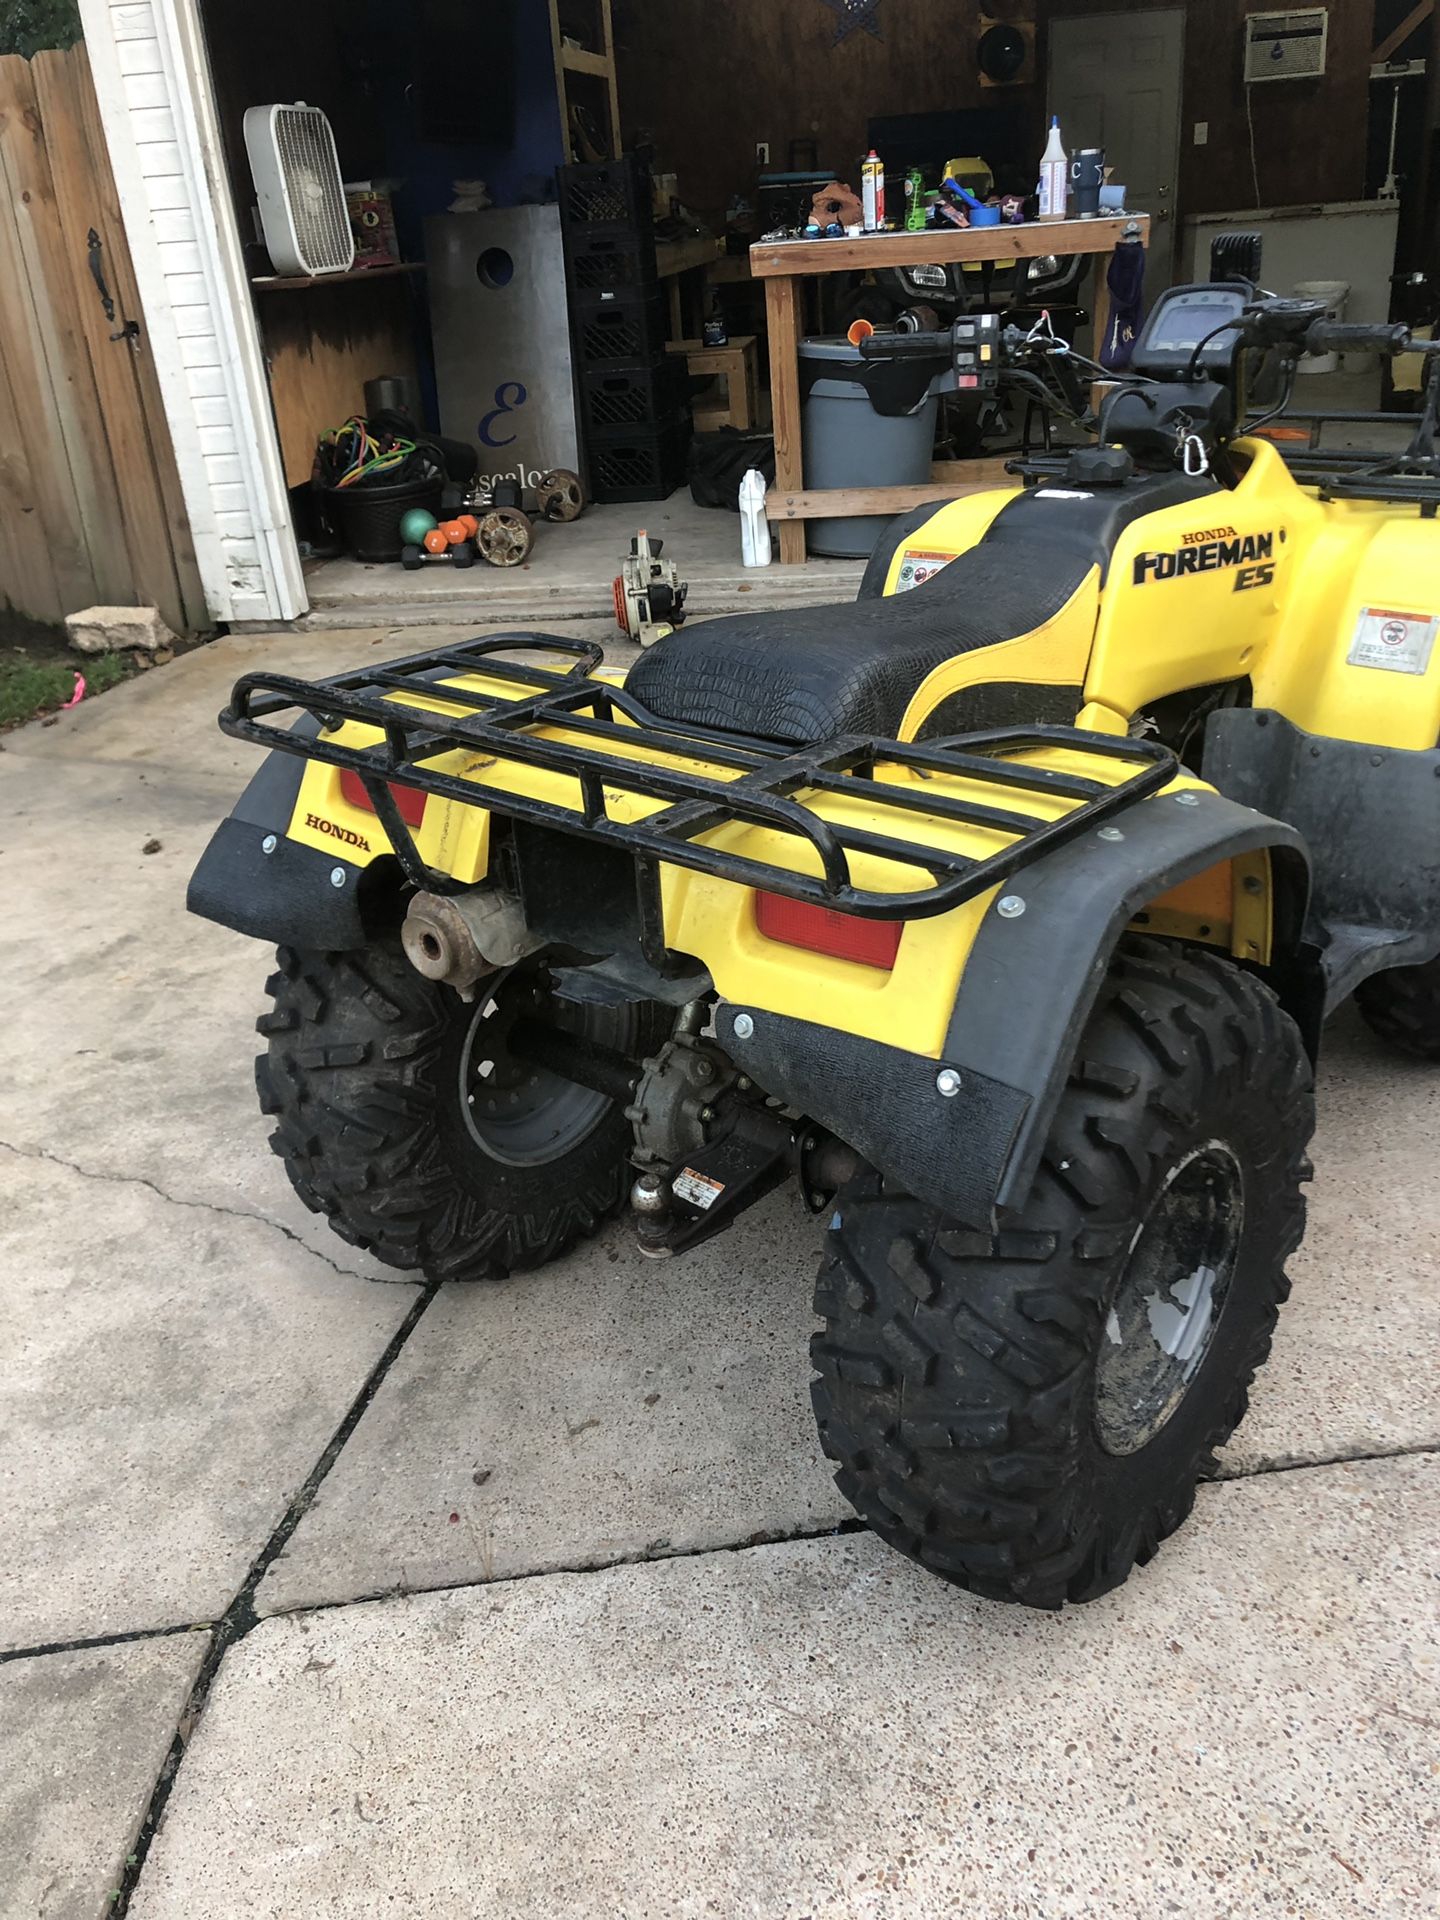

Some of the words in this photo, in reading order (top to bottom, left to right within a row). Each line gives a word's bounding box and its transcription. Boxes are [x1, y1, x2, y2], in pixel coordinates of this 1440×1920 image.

[1181, 526, 1238, 545] HONDA
[1133, 531, 1273, 585] FOREMAN
[1233, 562, 1276, 592] ES
[305, 813, 371, 852] HONDA
